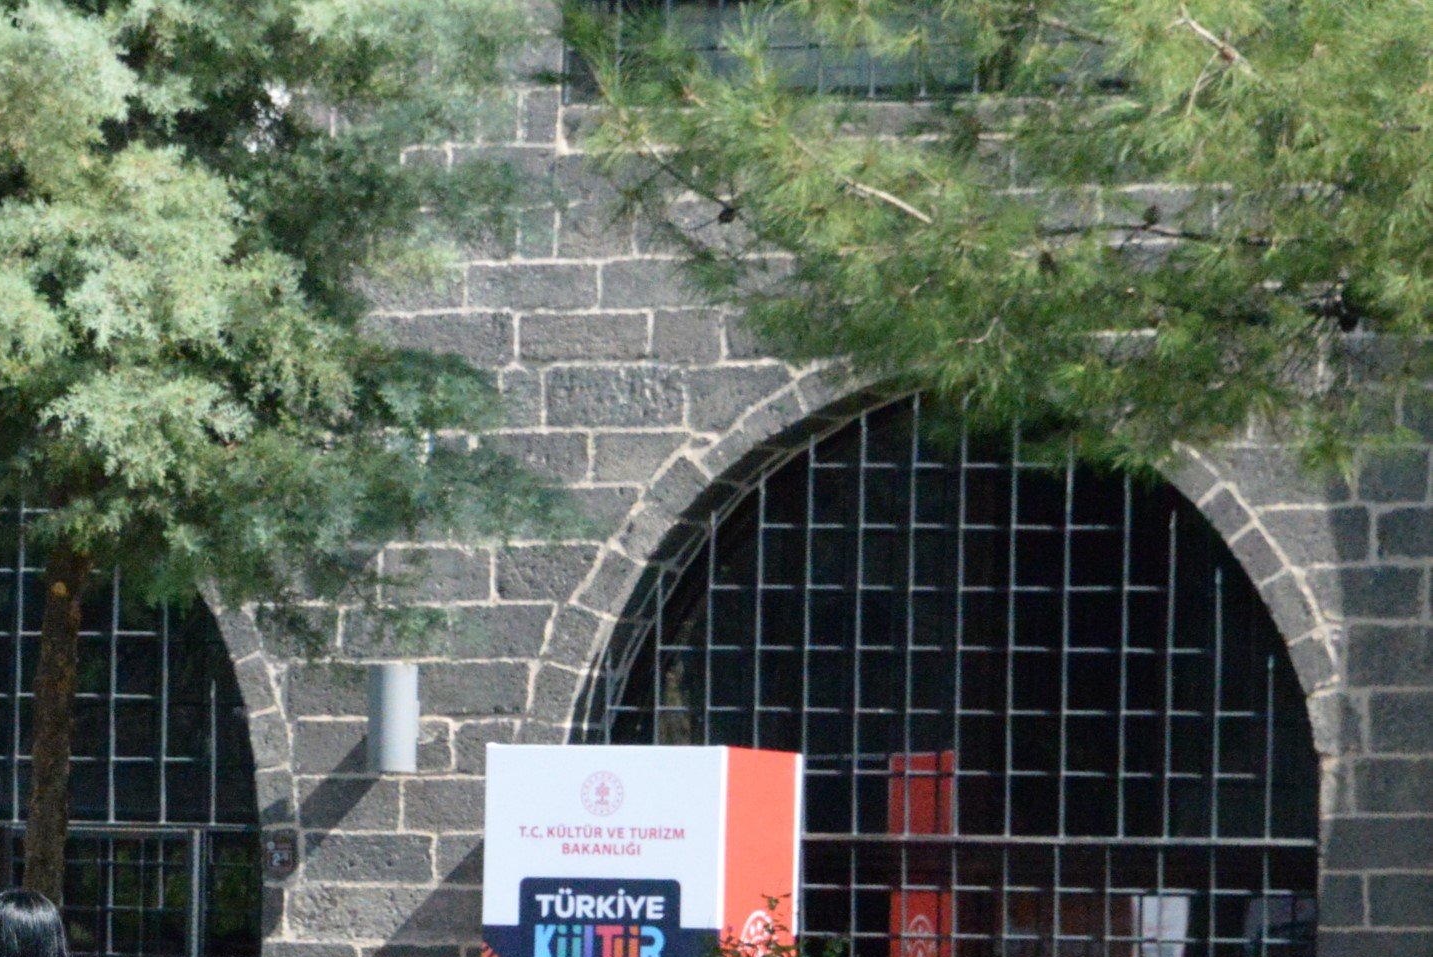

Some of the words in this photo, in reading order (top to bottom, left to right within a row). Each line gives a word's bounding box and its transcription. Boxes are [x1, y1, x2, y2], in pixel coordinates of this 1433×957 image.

[519, 825, 543, 839] T.C.
[547, 824, 602, 839] KÜLTÜR
[607, 827, 625, 840] VE
[630, 825, 685, 841] TURİZM
[562, 841, 641, 856] BAKANLIĞI
[535, 888, 665, 920] TÜRKİYE
